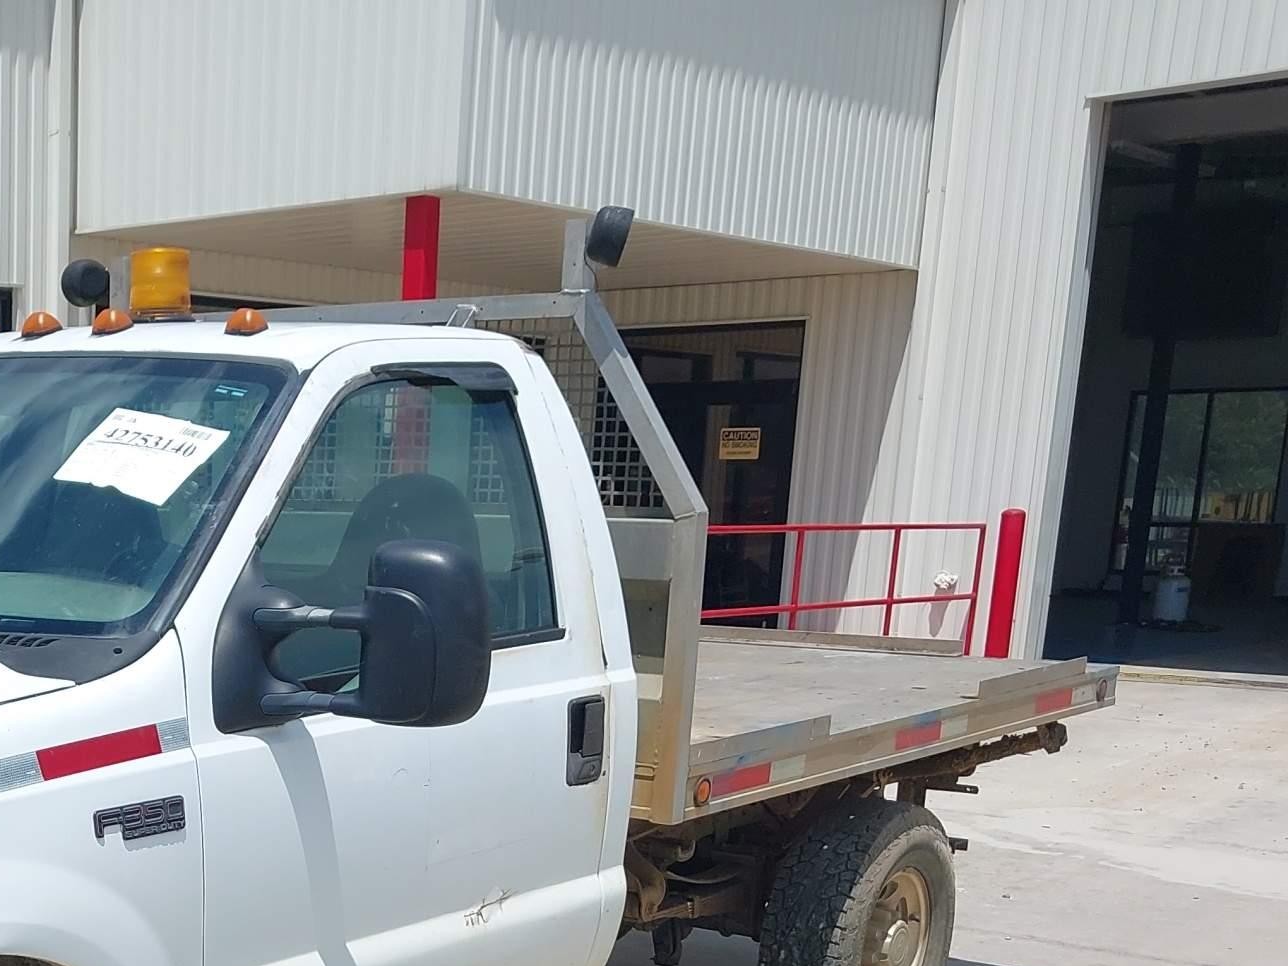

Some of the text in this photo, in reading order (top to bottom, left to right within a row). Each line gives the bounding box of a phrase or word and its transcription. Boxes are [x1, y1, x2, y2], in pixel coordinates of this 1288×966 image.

[103, 427, 198, 458] 42753140
[722, 431, 758, 440] CAUTION
[125, 819, 186, 839] SUPER DUTY
